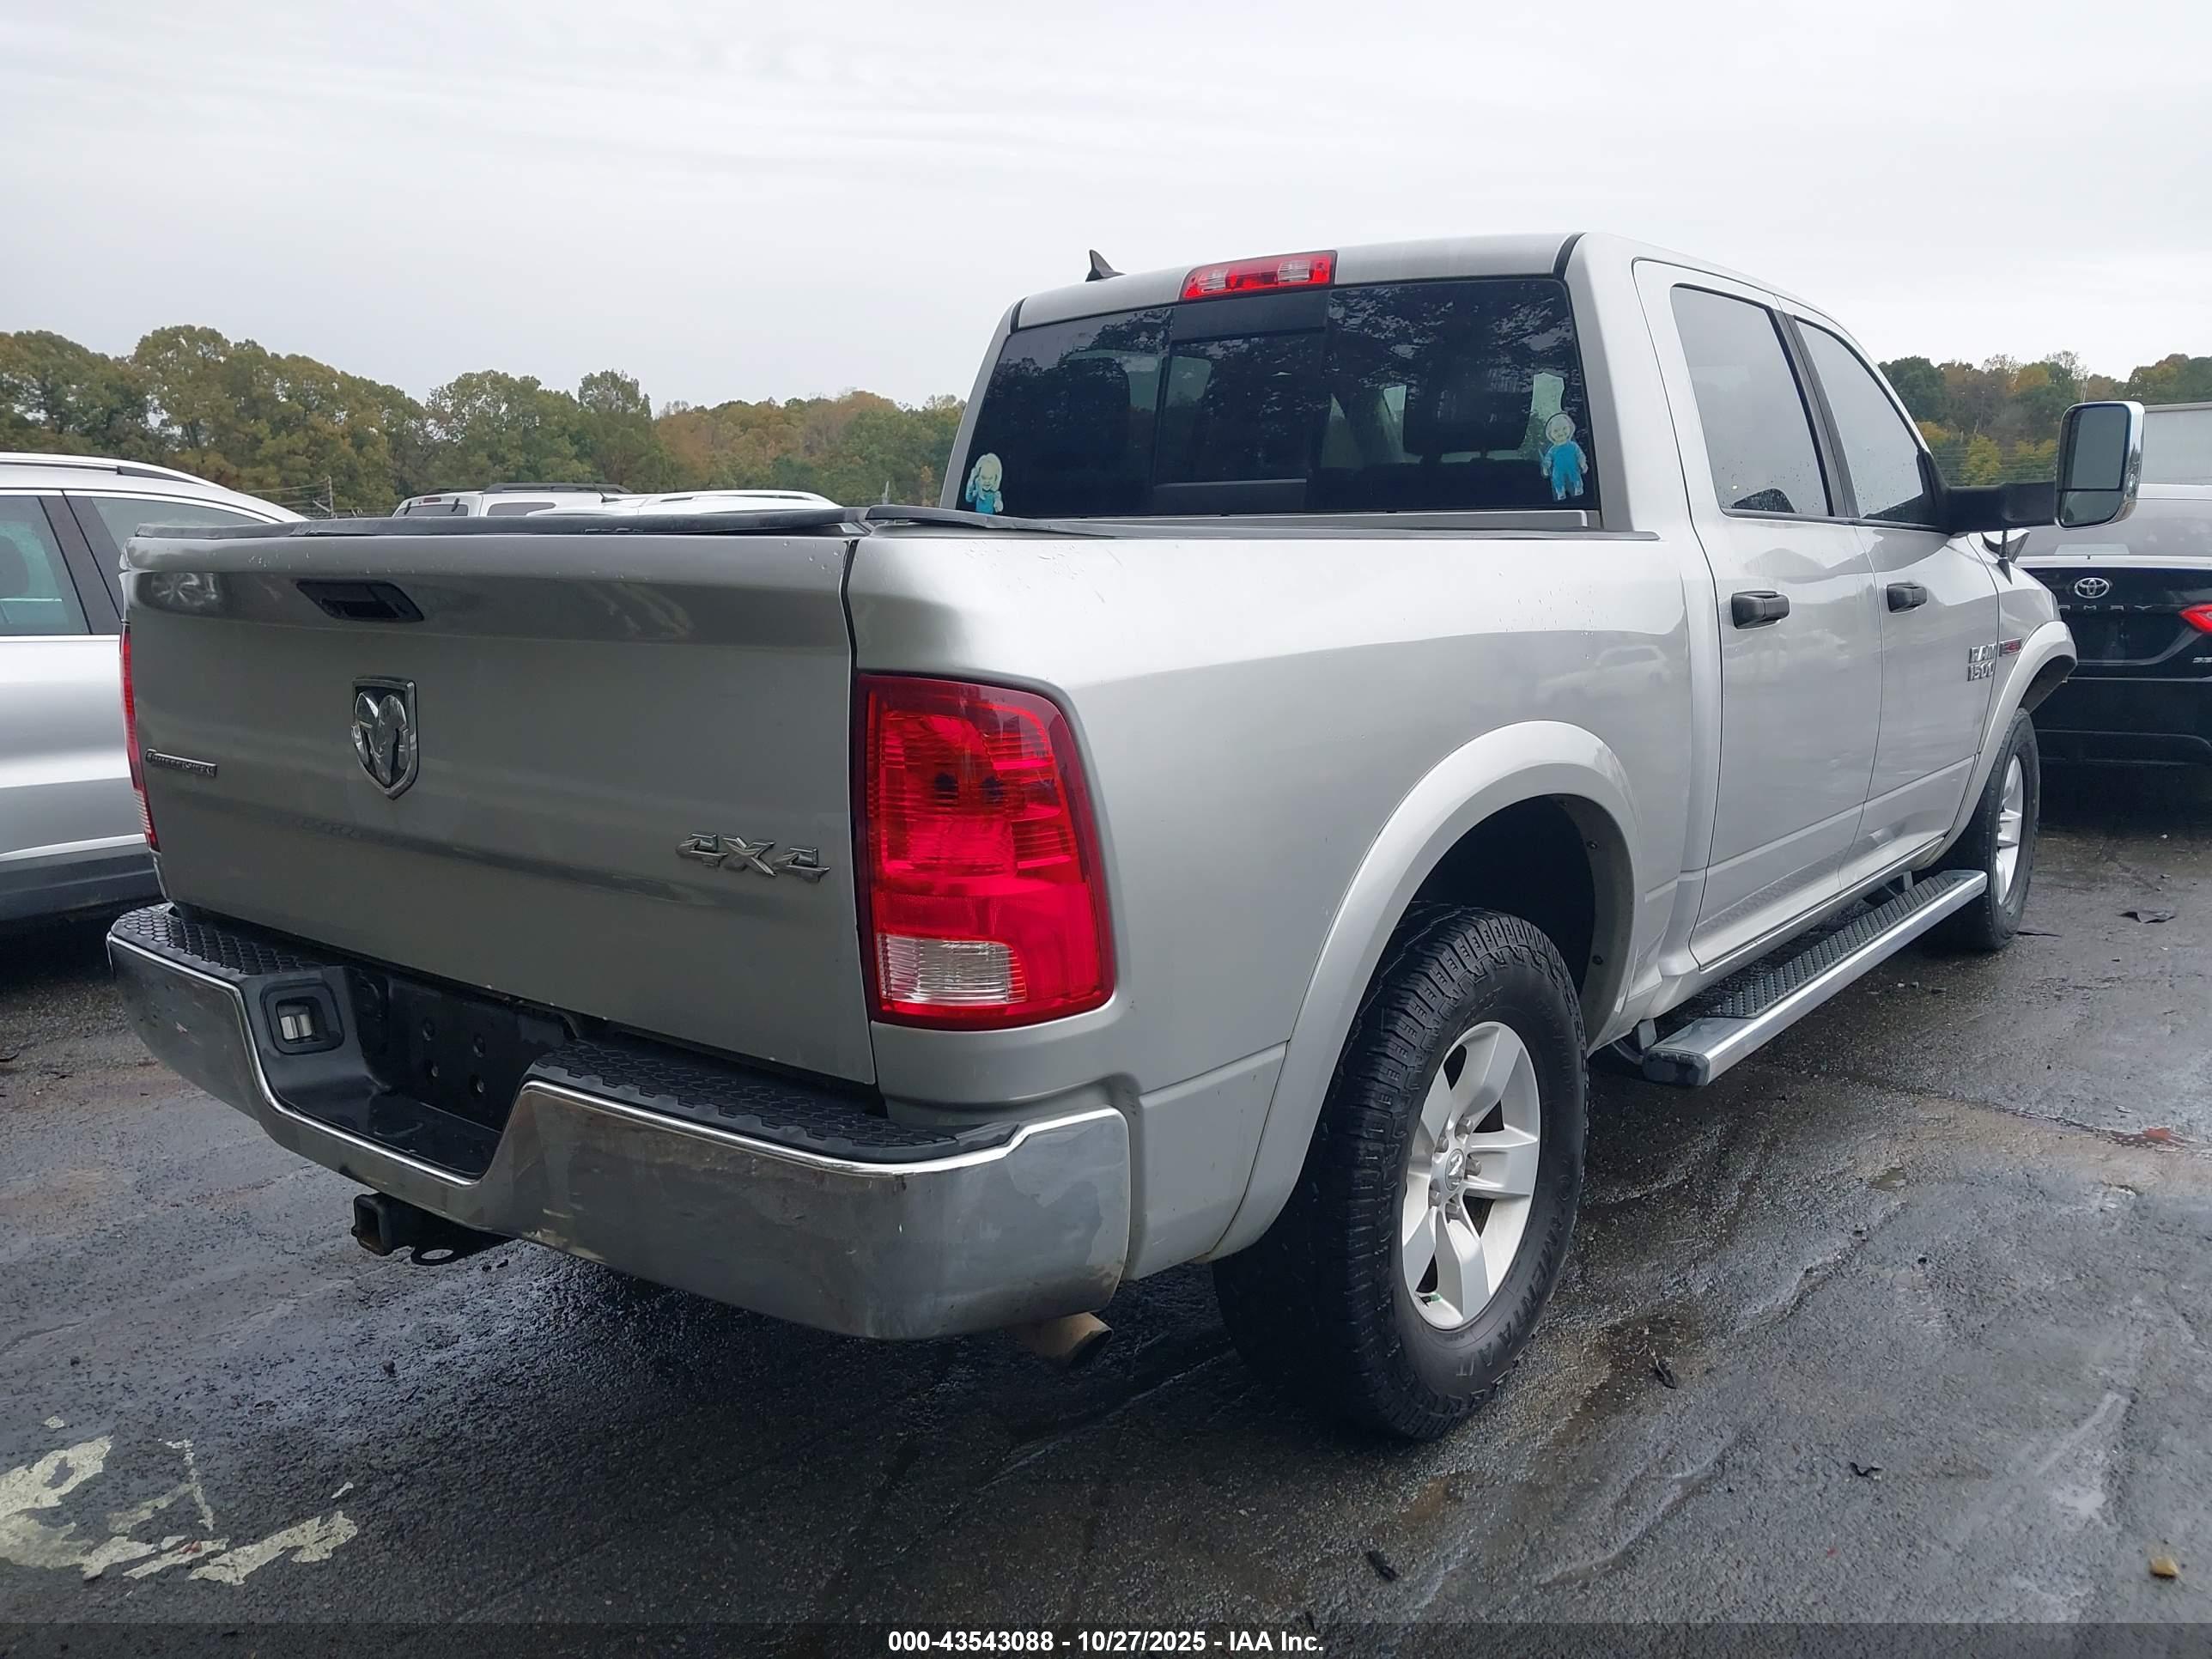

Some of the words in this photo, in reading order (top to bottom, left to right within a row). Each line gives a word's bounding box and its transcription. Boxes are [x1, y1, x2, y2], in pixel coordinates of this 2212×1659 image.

[2058, 604, 2154, 612] AMRY
[1967, 643, 1996, 664] RAM
[1966, 660, 1995, 682] 1500
